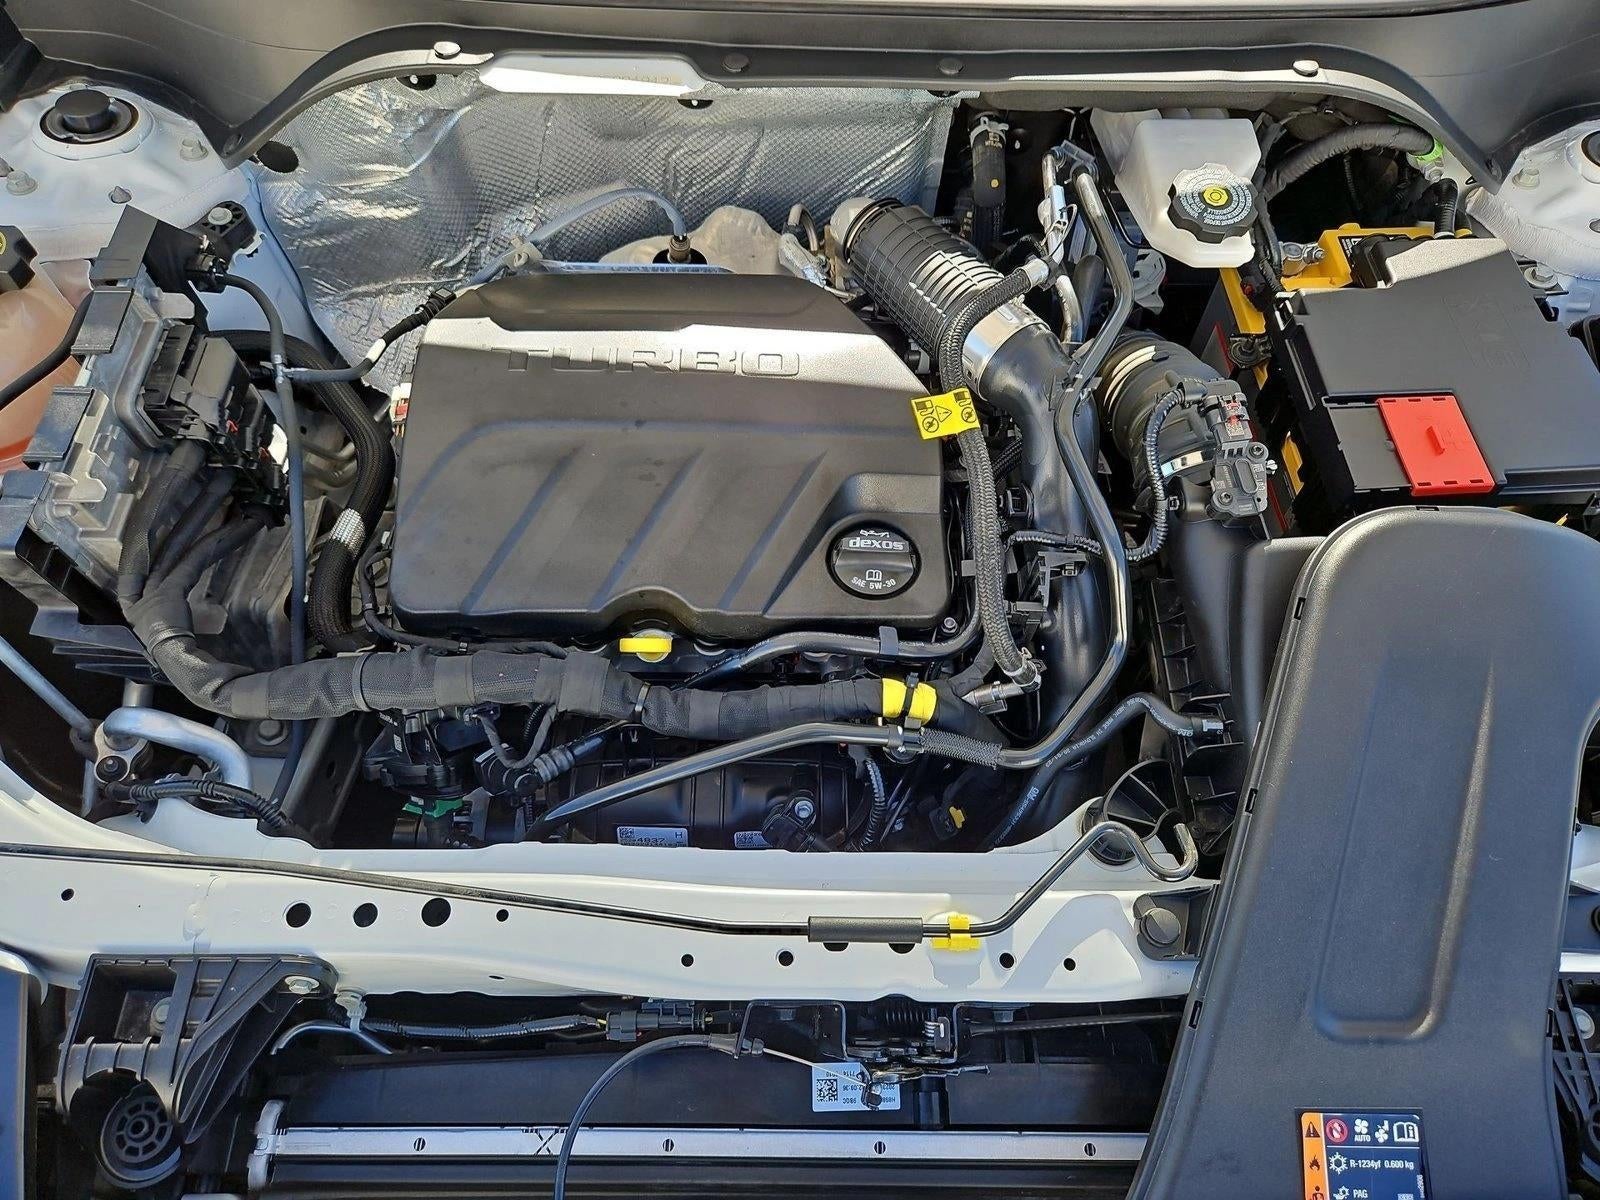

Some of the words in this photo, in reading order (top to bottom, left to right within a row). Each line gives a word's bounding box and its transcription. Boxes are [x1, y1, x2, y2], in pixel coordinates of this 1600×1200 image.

[491, 347, 800, 377] TURBO
[848, 537, 906, 551] dexos
[851, 576, 867, 588] SAE
[869, 578, 896, 590] 5W-30
[1354, 1134, 1371, 1142] AUTO
[1349, 1159, 1382, 1170] R-1234yf
[1384, 1160, 1404, 1169] 0.600
[1404, 1160, 1415, 1171] kg
[1353, 1189, 1368, 1199] PAG
